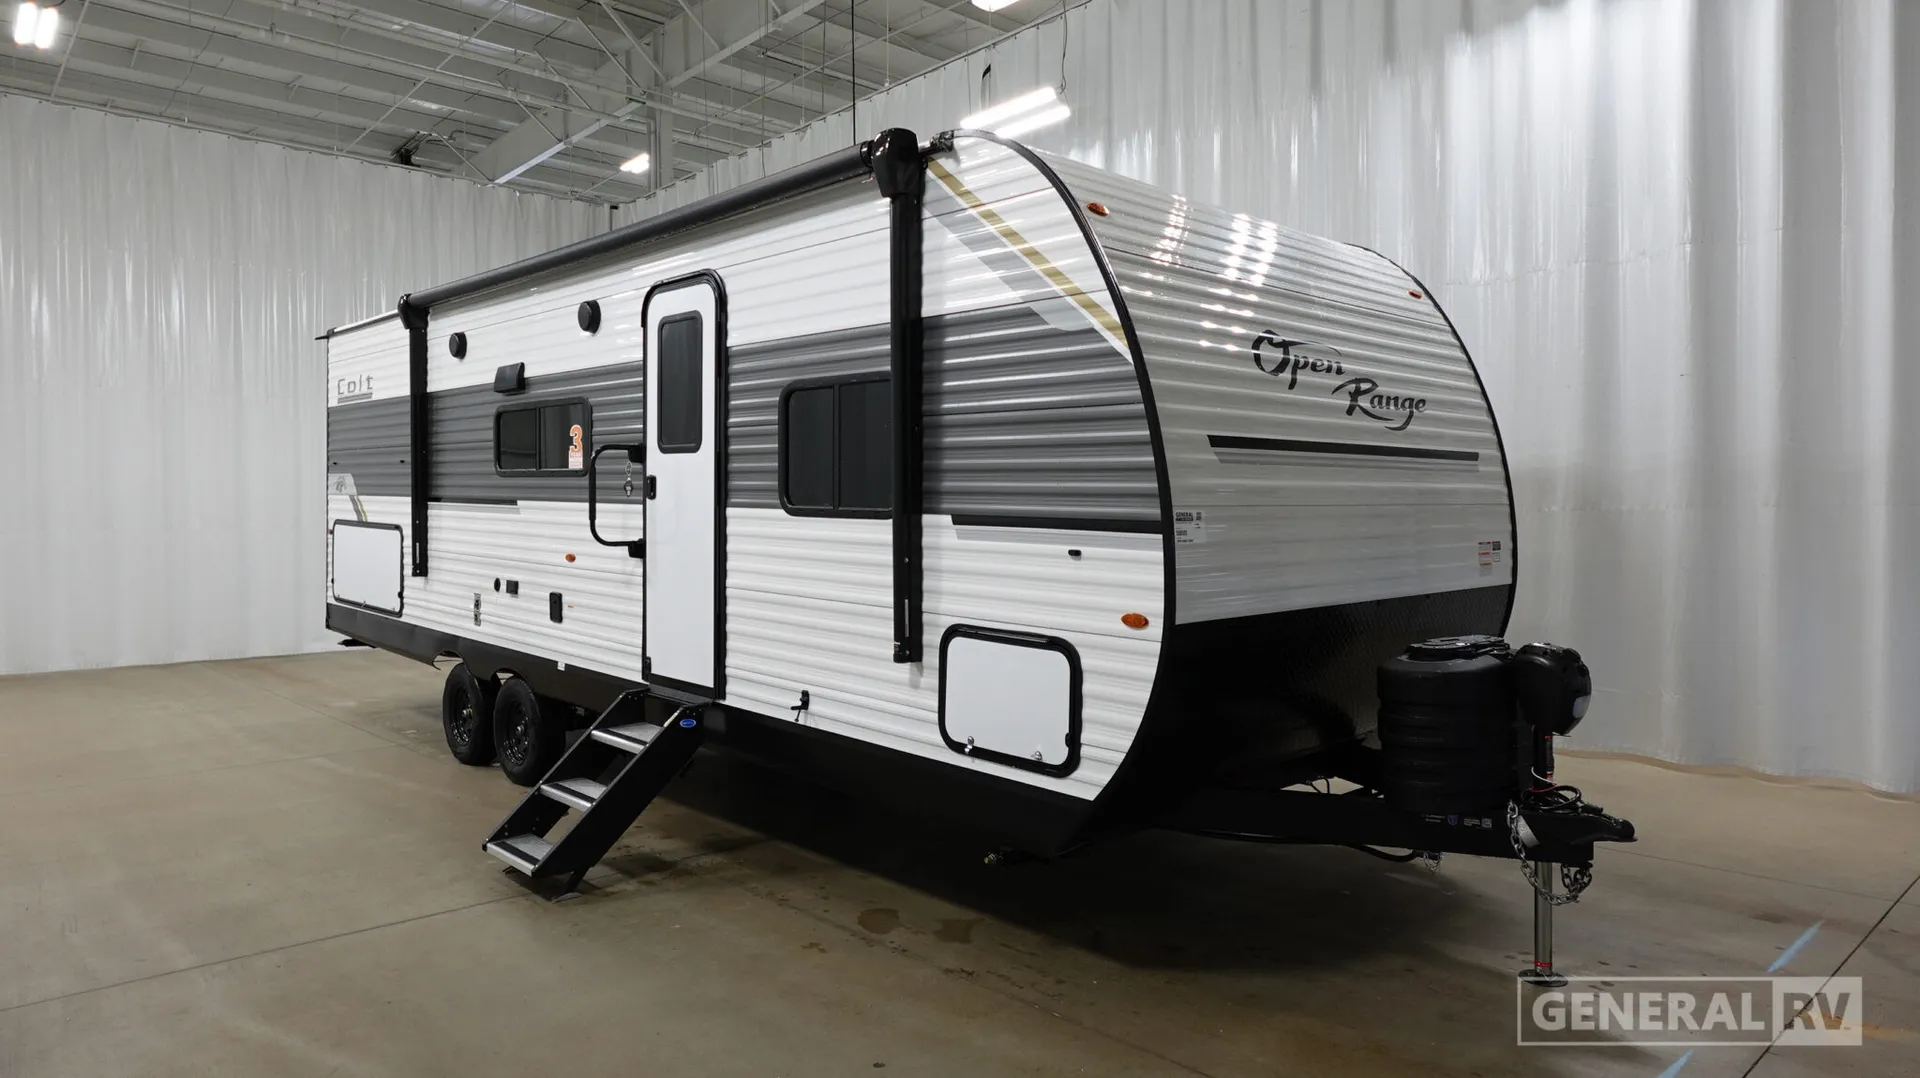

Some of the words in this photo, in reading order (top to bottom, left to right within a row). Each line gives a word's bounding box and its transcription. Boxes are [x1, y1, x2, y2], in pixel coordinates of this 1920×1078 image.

[1251, 329, 1345, 390] Open
[337, 374, 373, 395] Colt
[1331, 377, 1427, 431] Range
[570, 424, 583, 453] 3
